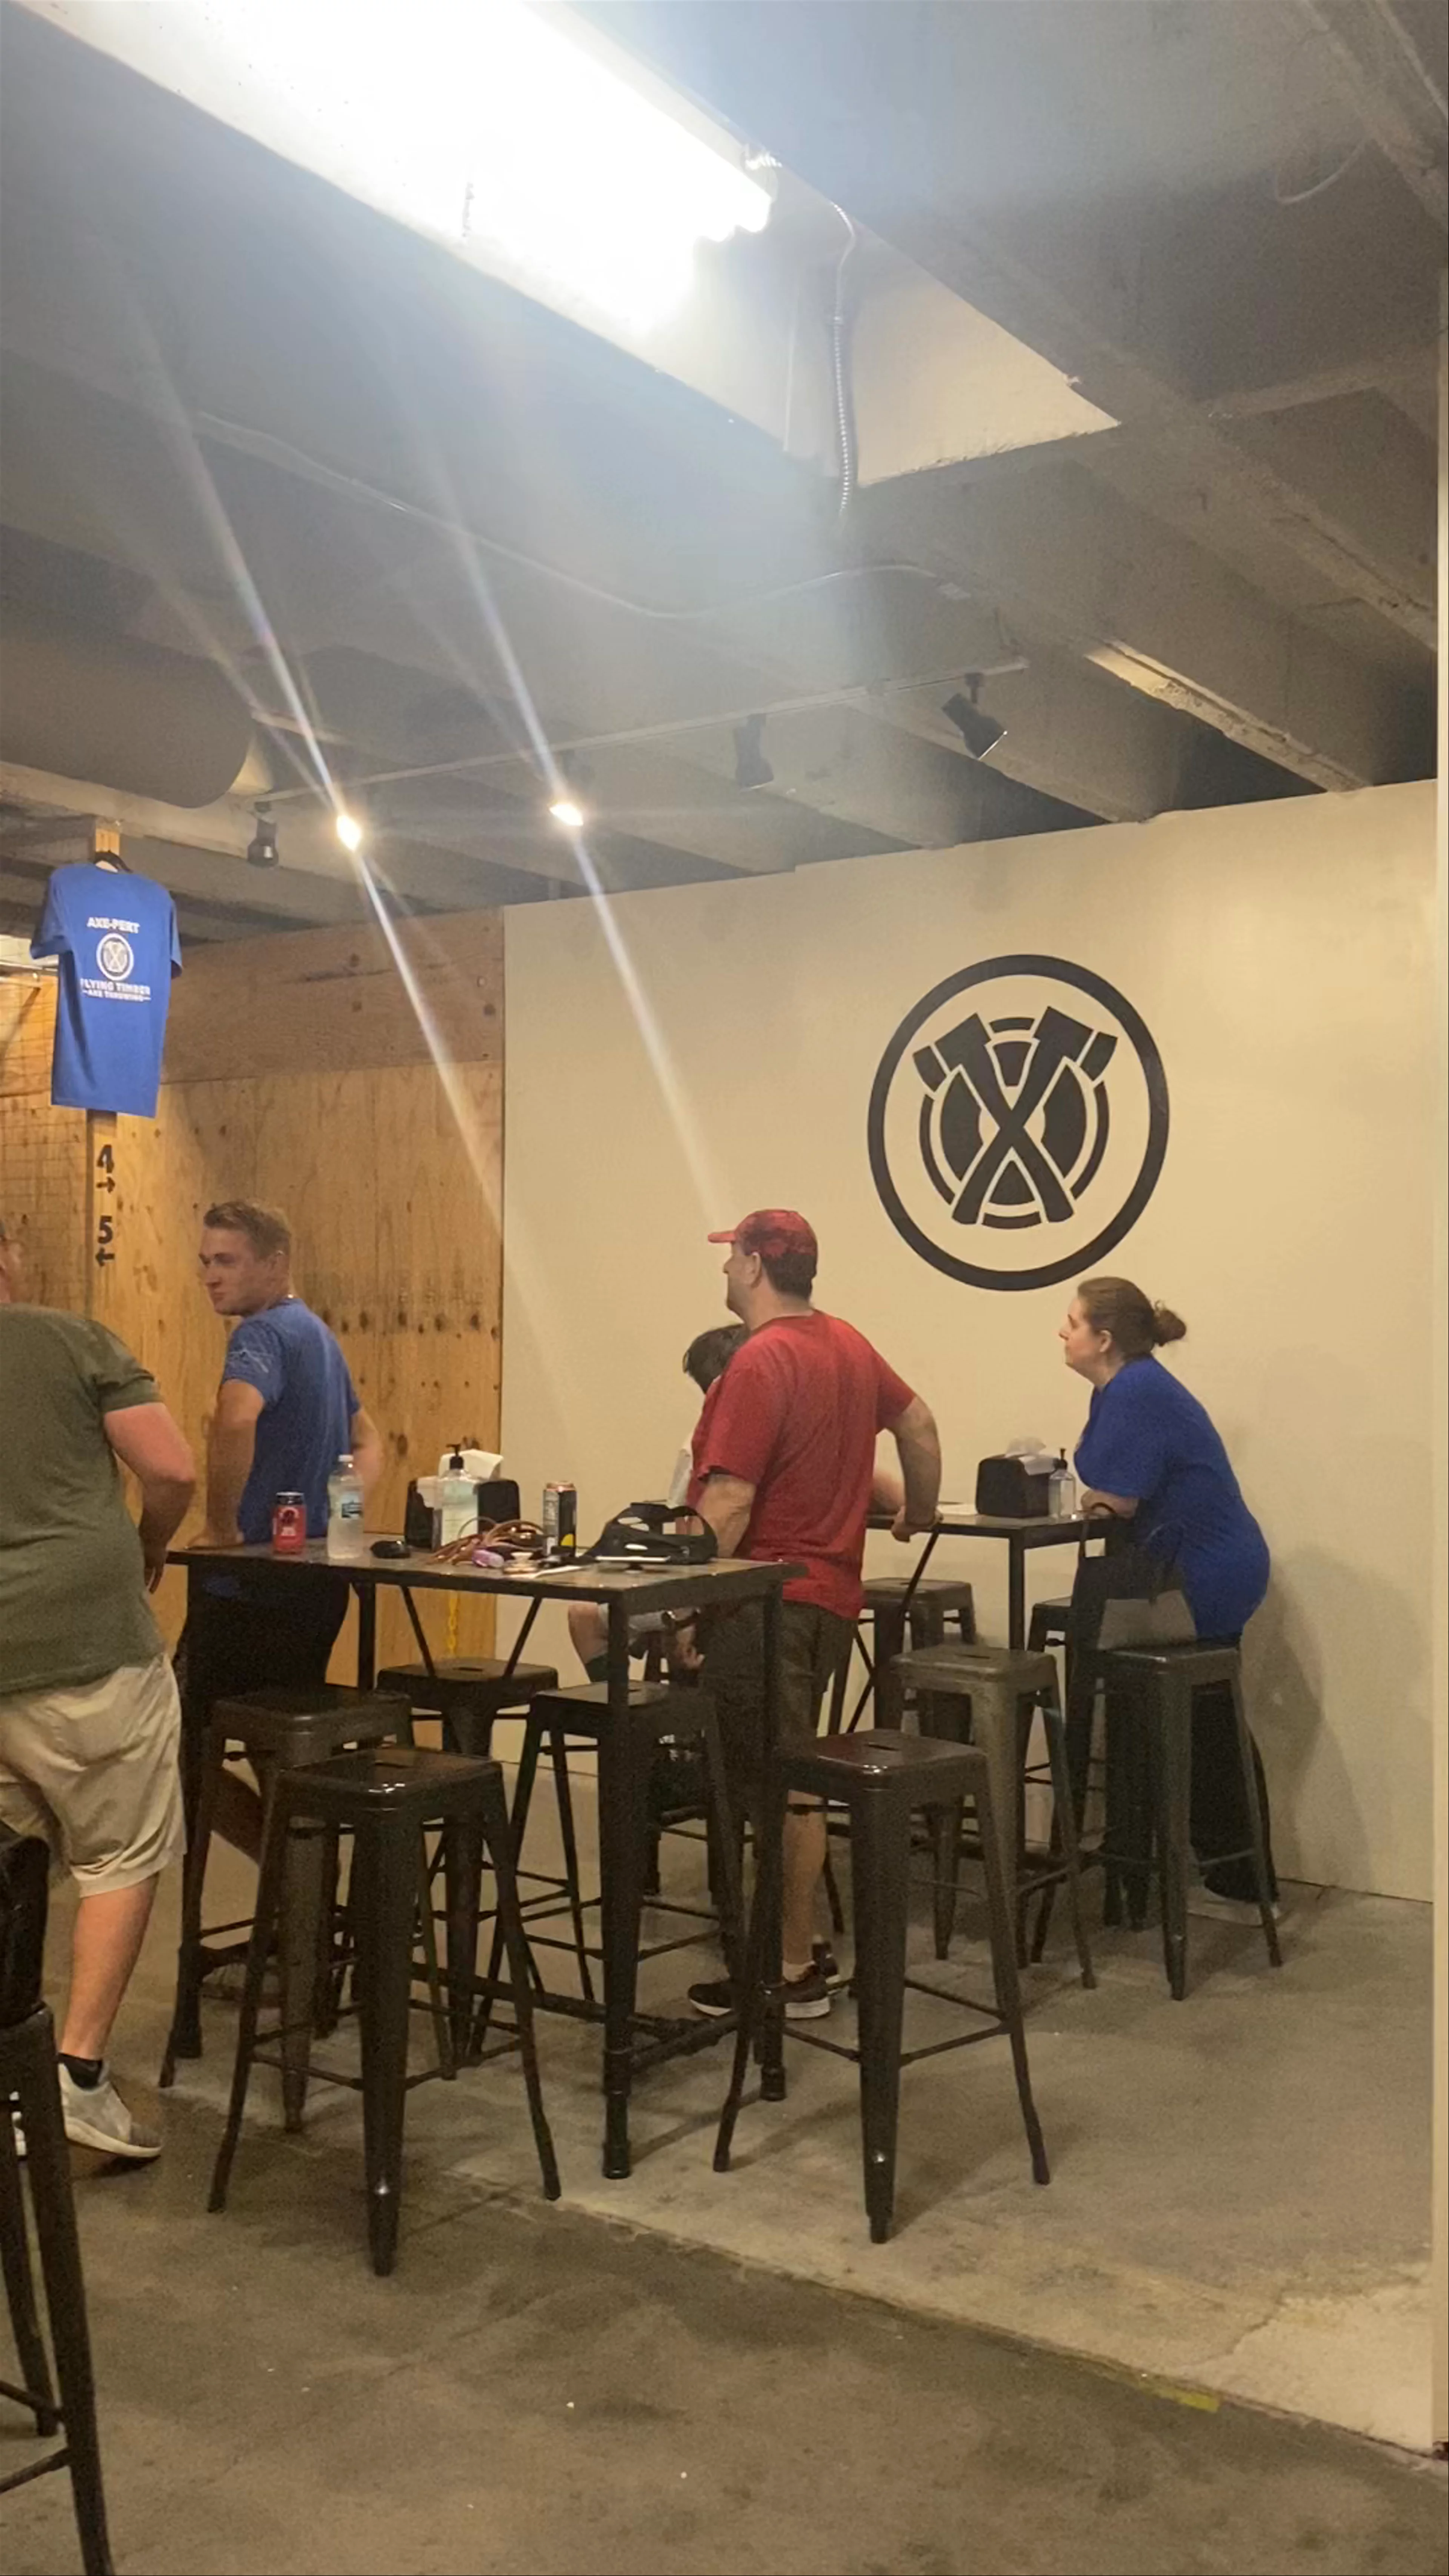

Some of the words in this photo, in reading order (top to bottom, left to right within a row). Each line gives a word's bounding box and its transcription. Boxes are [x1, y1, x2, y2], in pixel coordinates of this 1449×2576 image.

[86, 917, 140, 934] AXE-PERT
[115, 983, 150, 995] TIMBER
[97, 1144, 114, 1173] 4
[98, 1215, 113, 1244] 5
